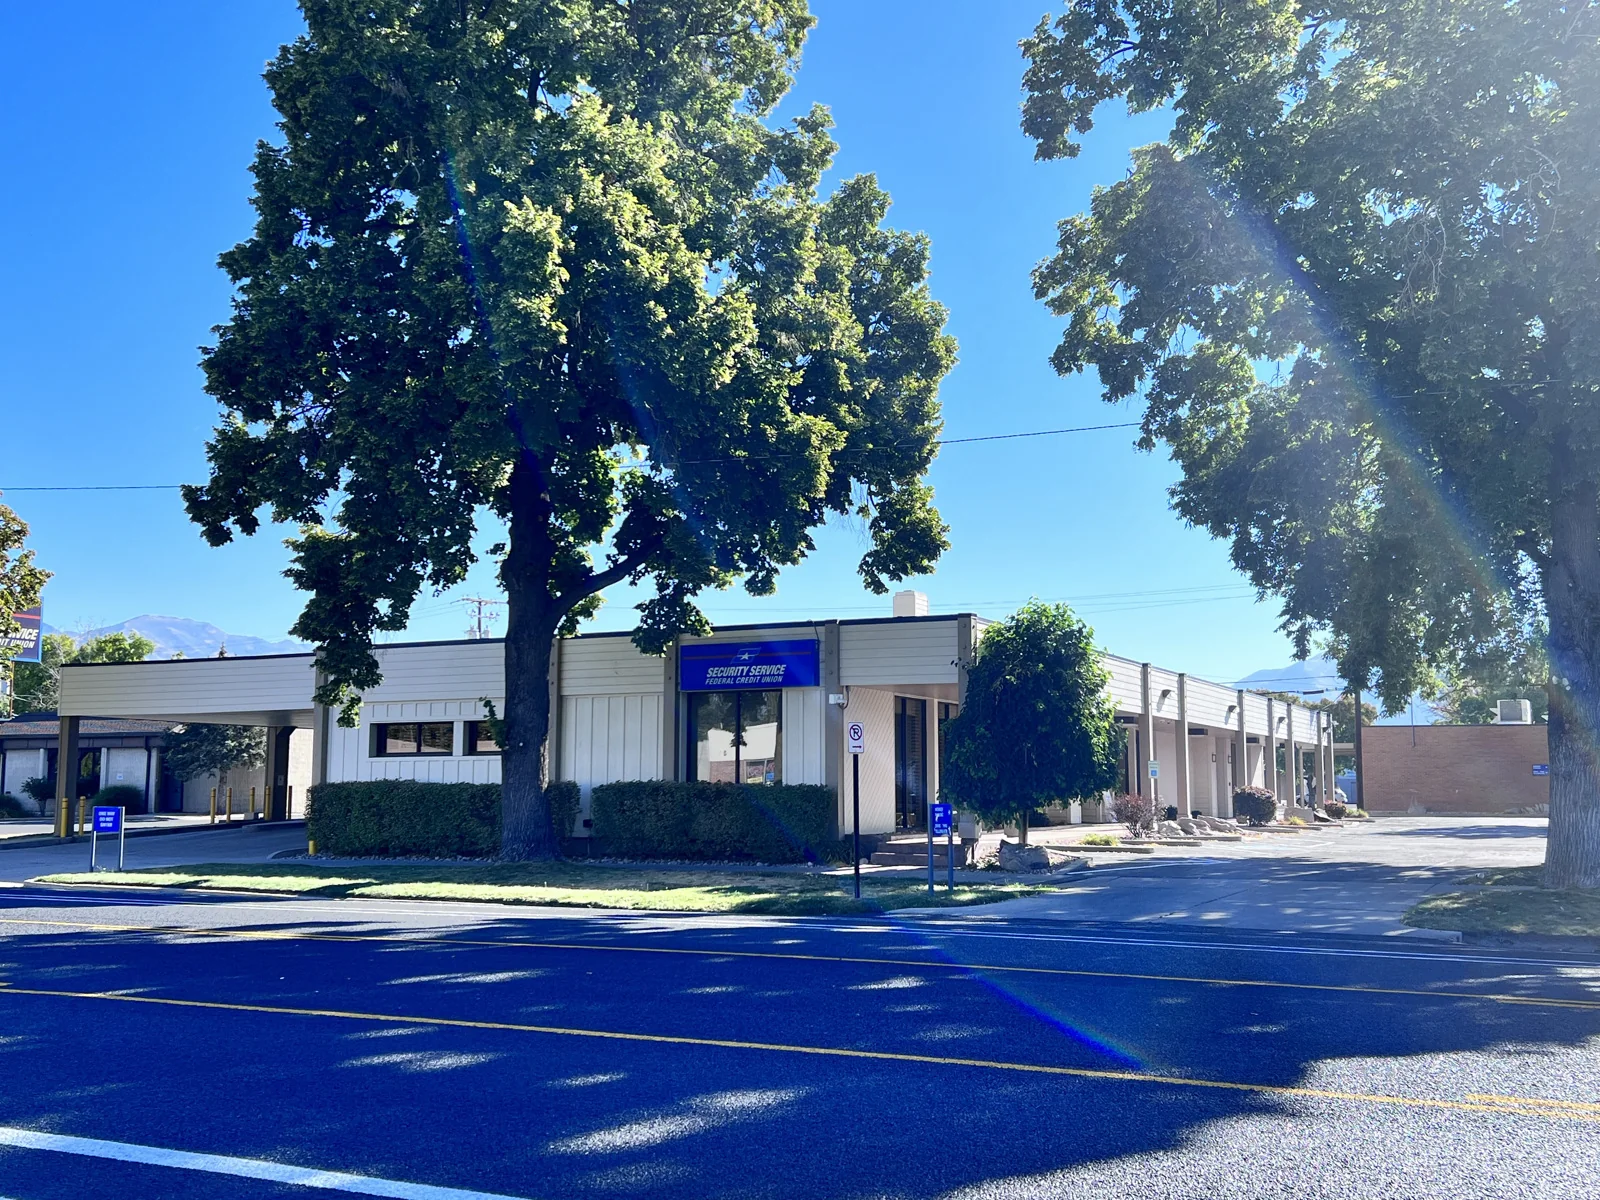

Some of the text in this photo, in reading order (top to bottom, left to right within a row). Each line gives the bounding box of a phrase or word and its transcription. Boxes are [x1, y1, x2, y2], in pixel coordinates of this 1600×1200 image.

[10, 639, 35, 649] UNION
[706, 664, 786, 677] SECURITY SERVICE
